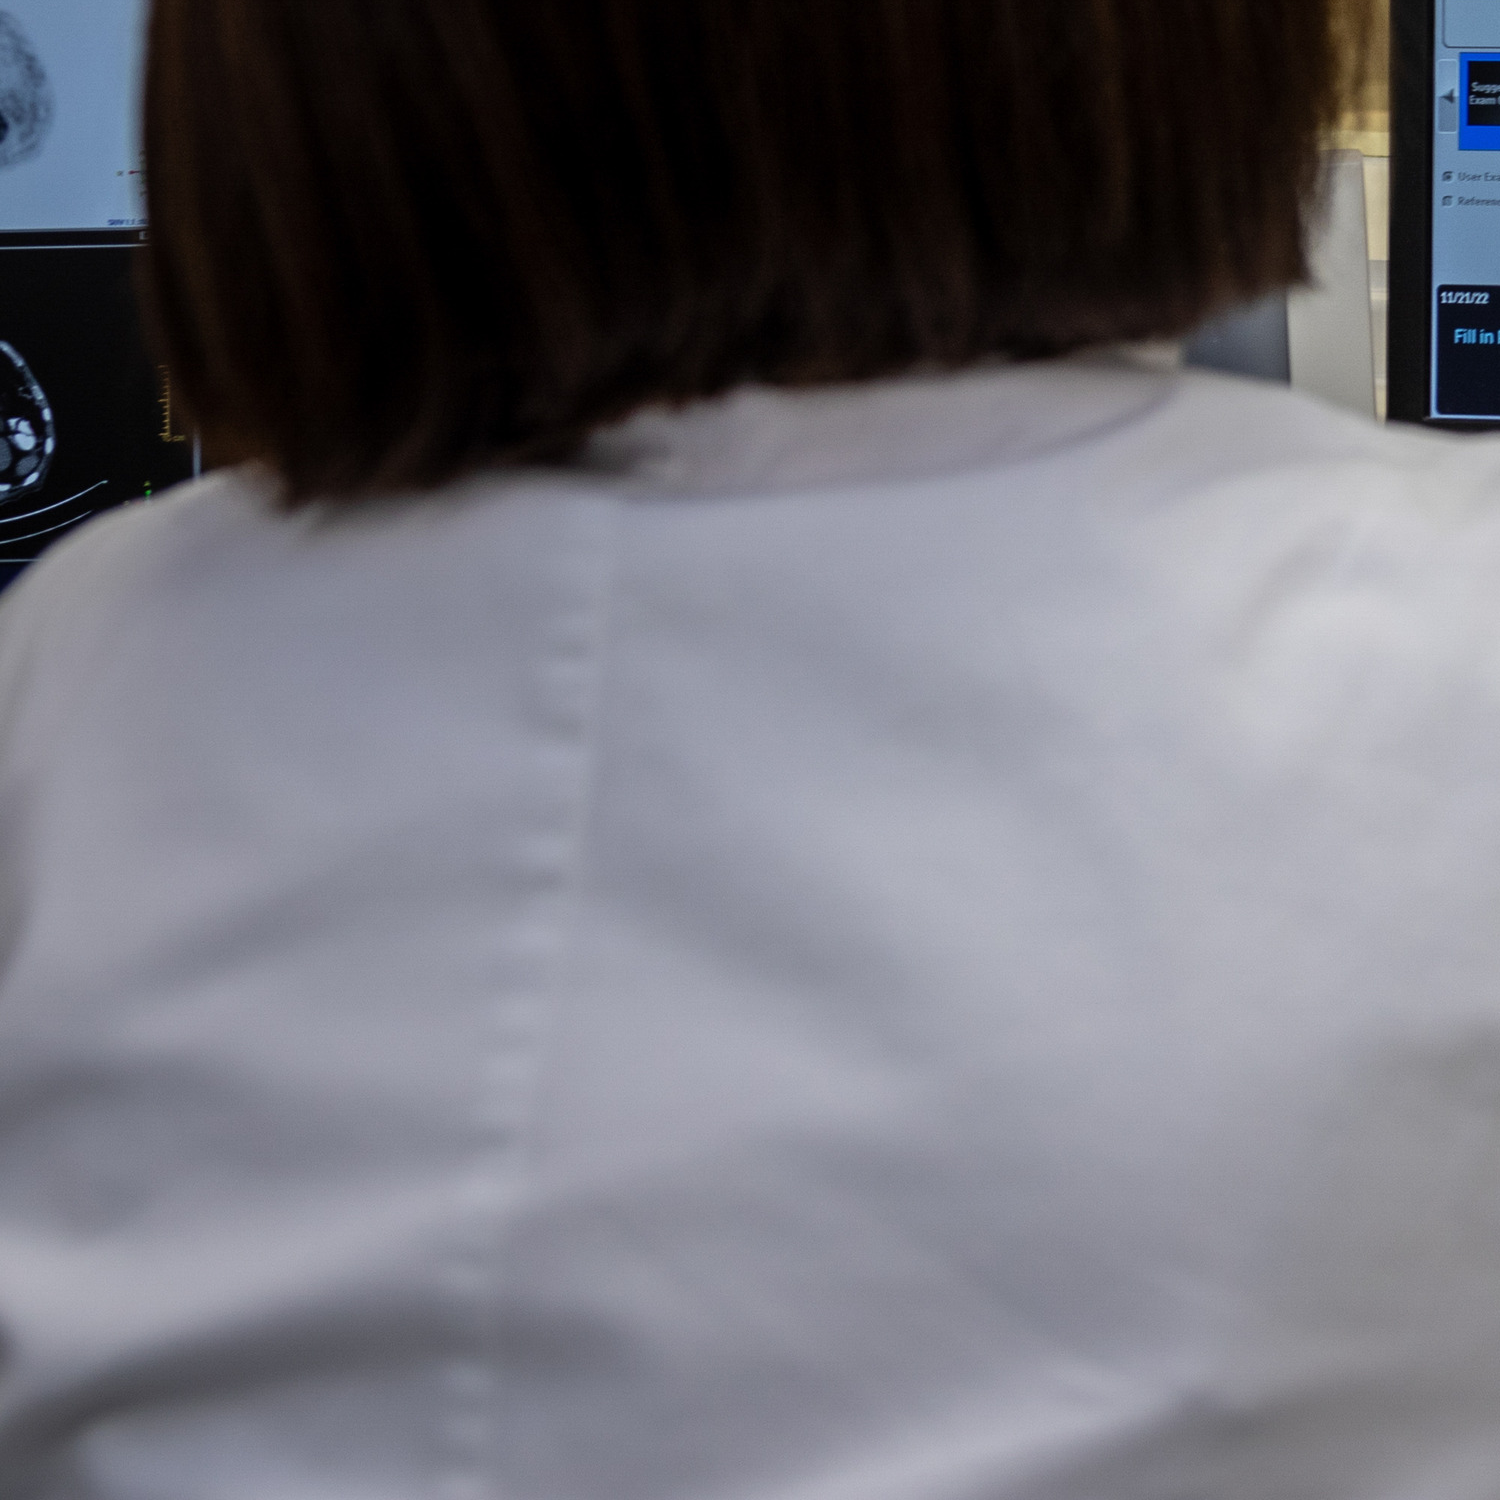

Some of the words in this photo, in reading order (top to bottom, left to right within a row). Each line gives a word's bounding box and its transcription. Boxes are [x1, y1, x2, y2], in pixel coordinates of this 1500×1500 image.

[1469, 95, 1495, 106] Exam
[1457, 172, 1482, 182] User
[1440, 291, 1490, 305] 11/21/22
[1454, 328, 1477, 344] Fill
[1480, 328, 1494, 345] in
